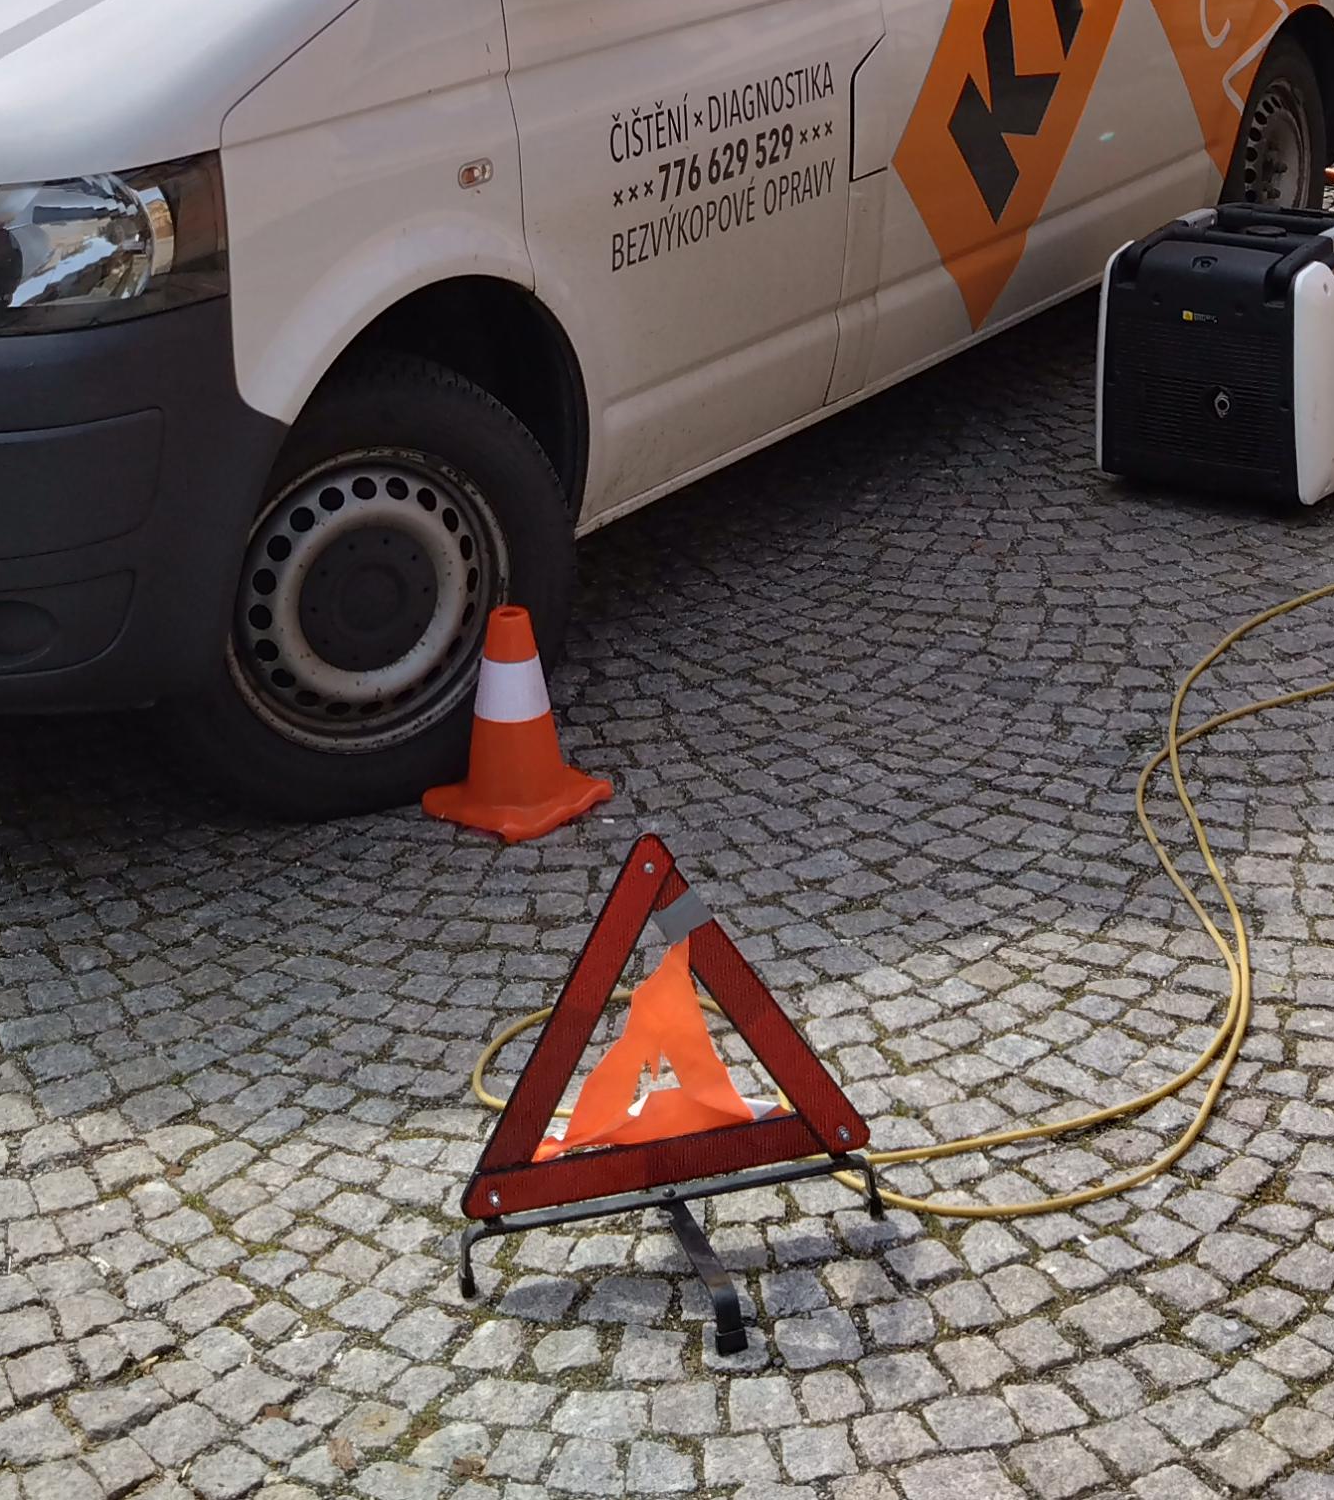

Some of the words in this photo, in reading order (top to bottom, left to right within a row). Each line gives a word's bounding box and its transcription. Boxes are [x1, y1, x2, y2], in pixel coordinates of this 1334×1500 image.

[609, 92, 689, 164] ČIŠTĚNÍ
[707, 61, 835, 133] DIAGNOSTIKA
[658, 153, 702, 203] 776
[707, 138, 749, 185] 629
[755, 123, 794, 169] 529
[611, 176, 756, 272] BEZVÝKOPOVÉ
[763, 157, 836, 216] OPRAVY
